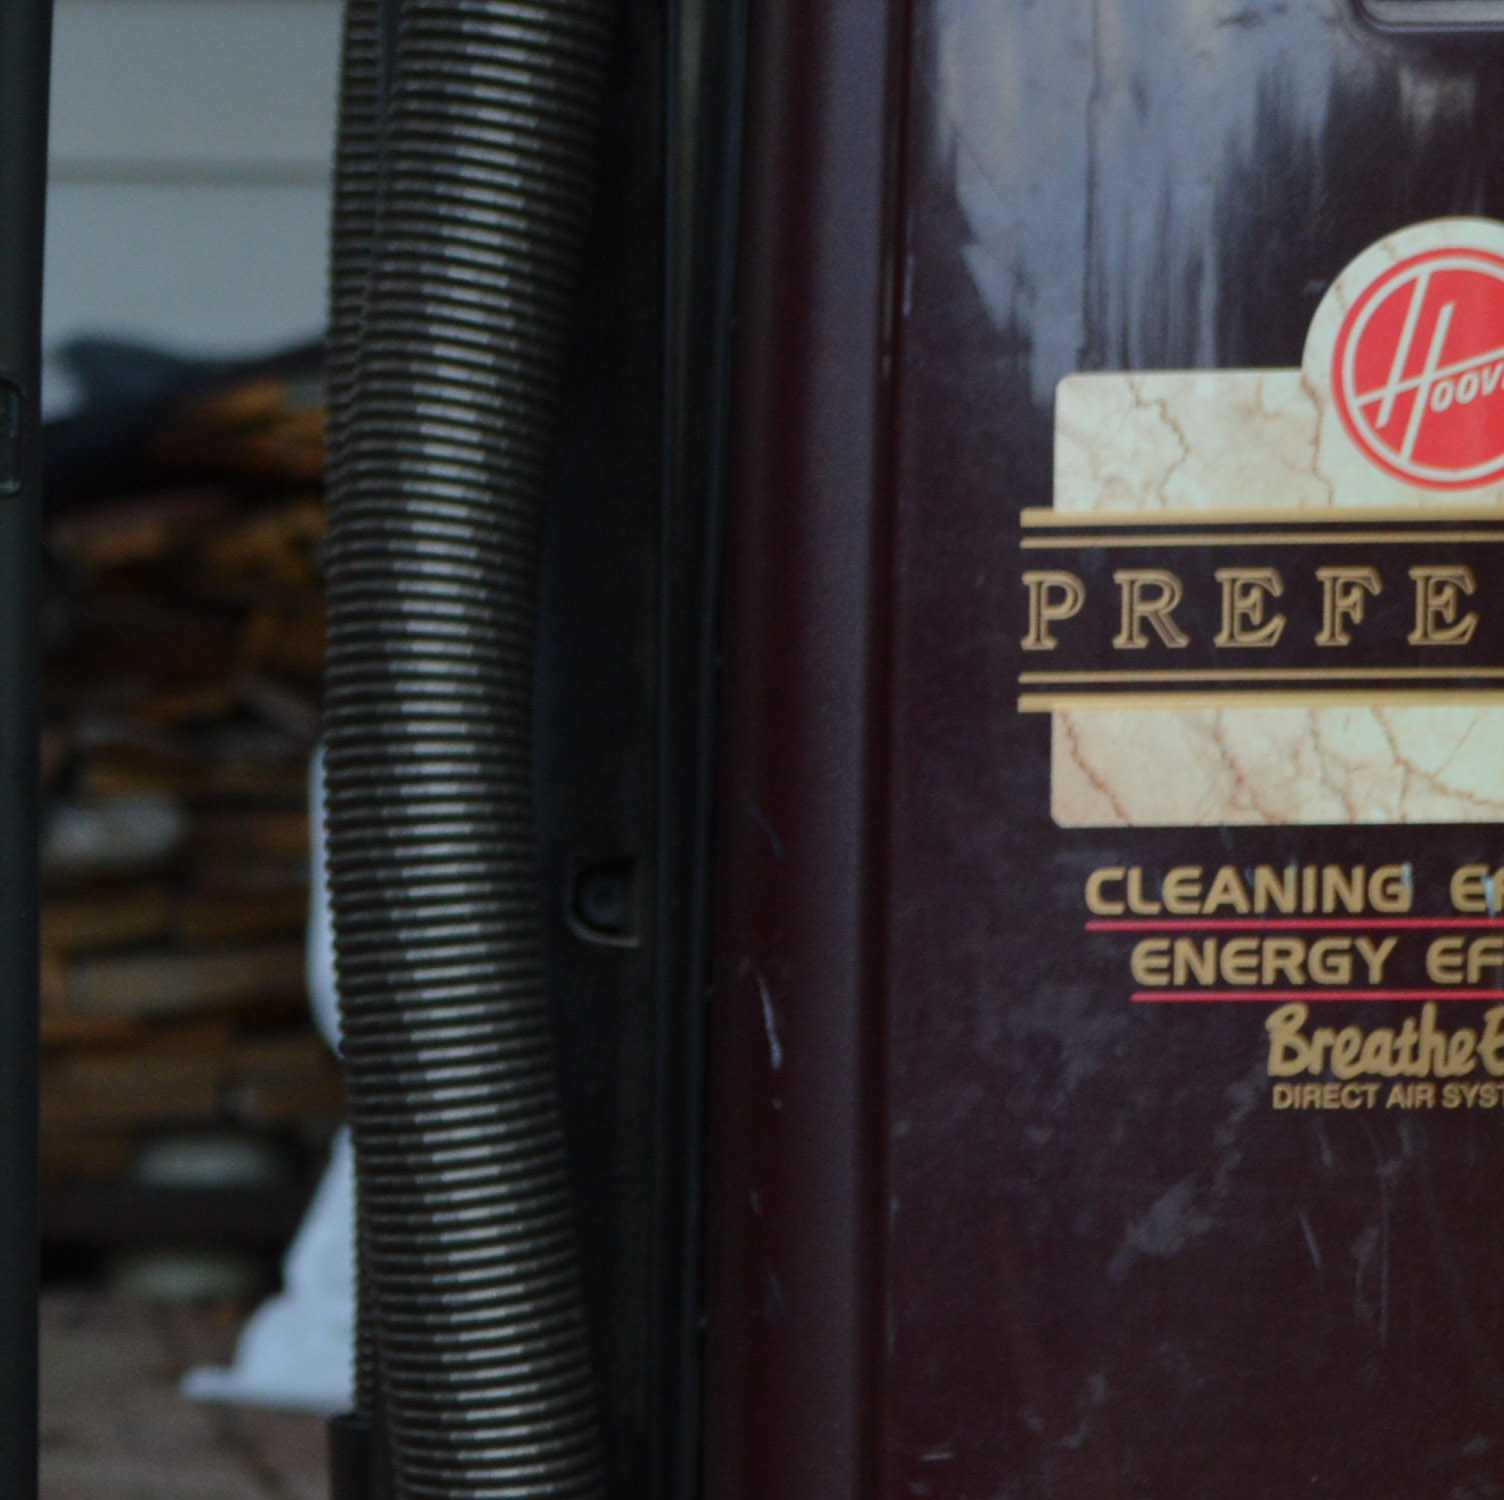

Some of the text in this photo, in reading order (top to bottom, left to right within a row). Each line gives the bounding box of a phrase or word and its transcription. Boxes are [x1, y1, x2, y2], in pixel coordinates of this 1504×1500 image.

[1020, 566, 1480, 650] PREFE
[1085, 863, 1504, 916] CLEANING E
[1131, 936, 1504, 987] ENERGY EF
[1272, 1082, 1381, 1110] DIRECT
[1385, 1082, 1435, 1109] AIR
